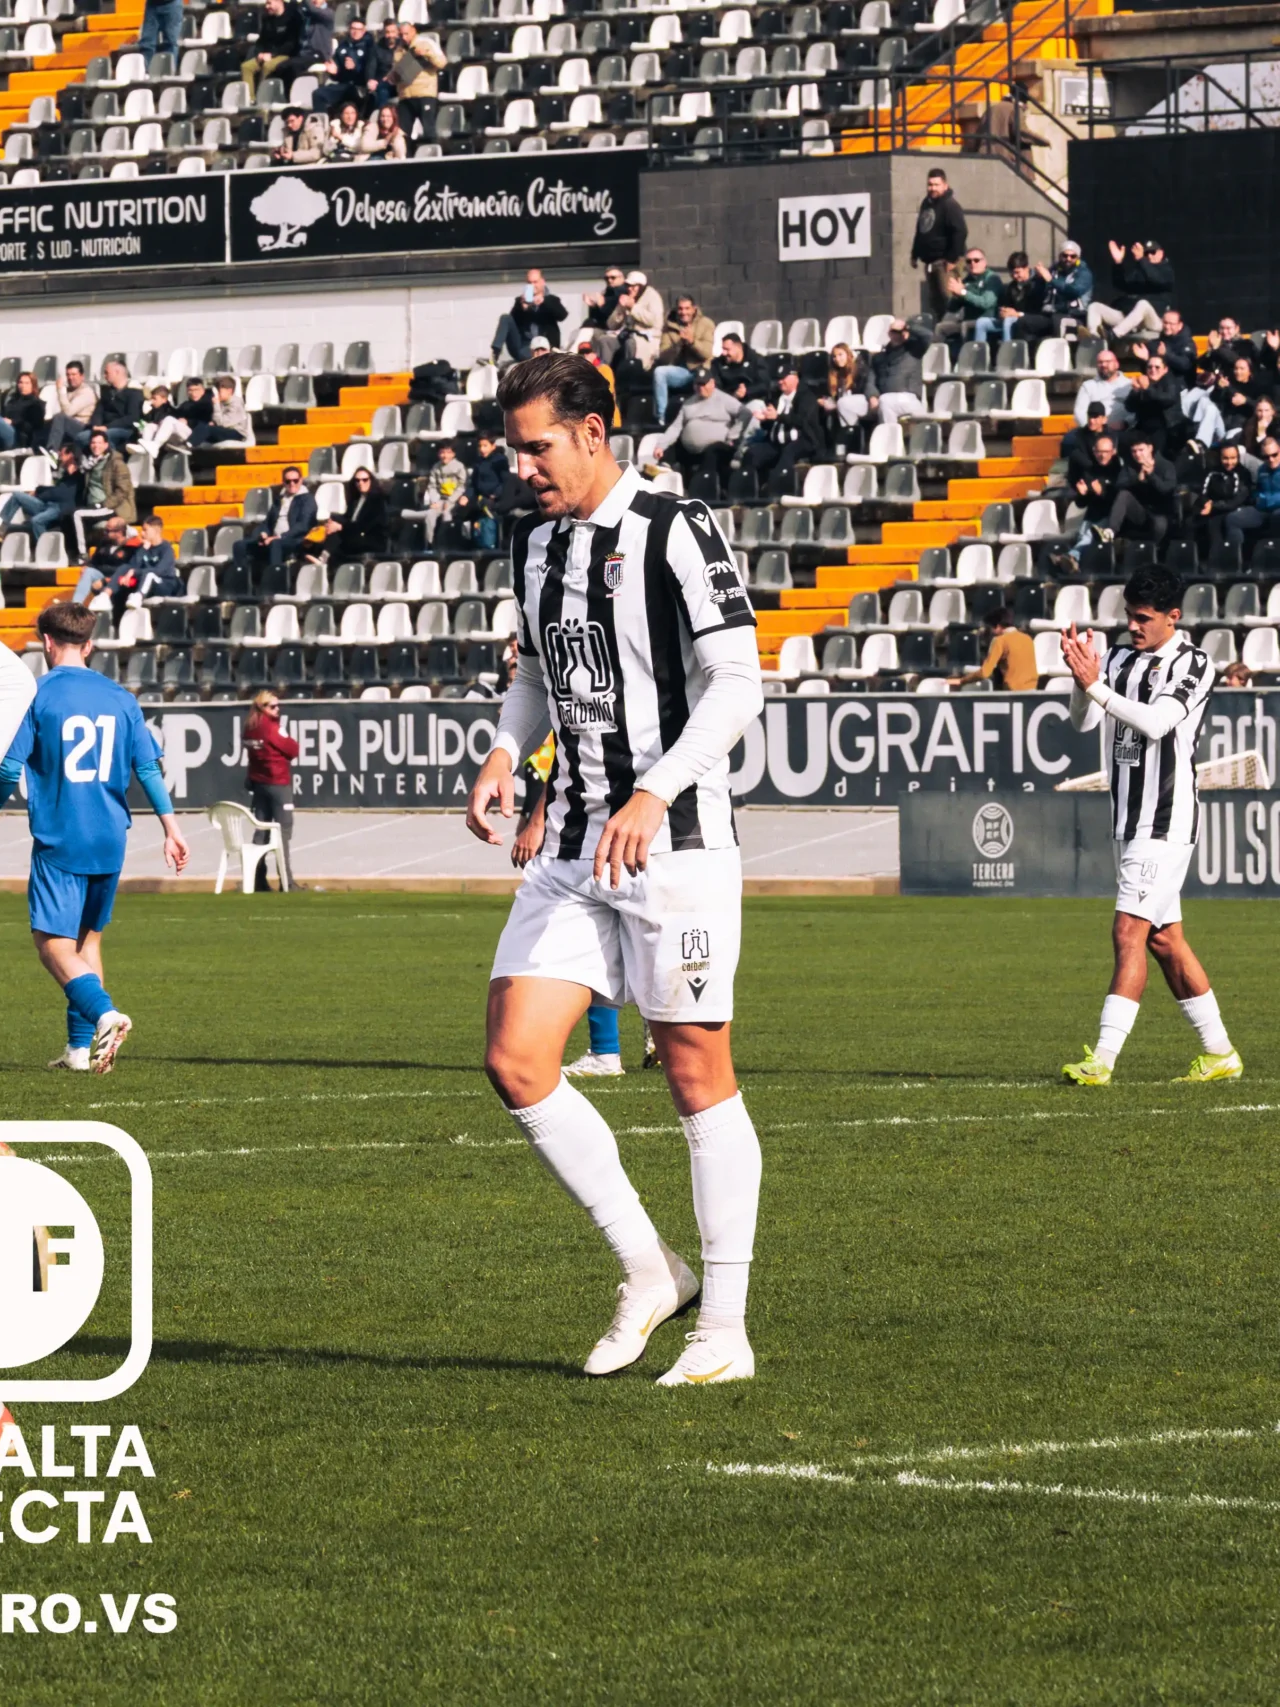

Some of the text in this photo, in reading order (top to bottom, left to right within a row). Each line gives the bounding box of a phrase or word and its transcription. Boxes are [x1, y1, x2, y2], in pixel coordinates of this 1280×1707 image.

[65, 195, 206, 229] NUTRITION
[527, 177, 617, 236] Catering
[782, 206, 865, 248] HOY
[81, 231, 141, 257] NUTRICIÓN
[62, 715, 116, 783] 21
[359, 714, 497, 771] PULIDO
[972, 863, 1015, 880] TERCERA
